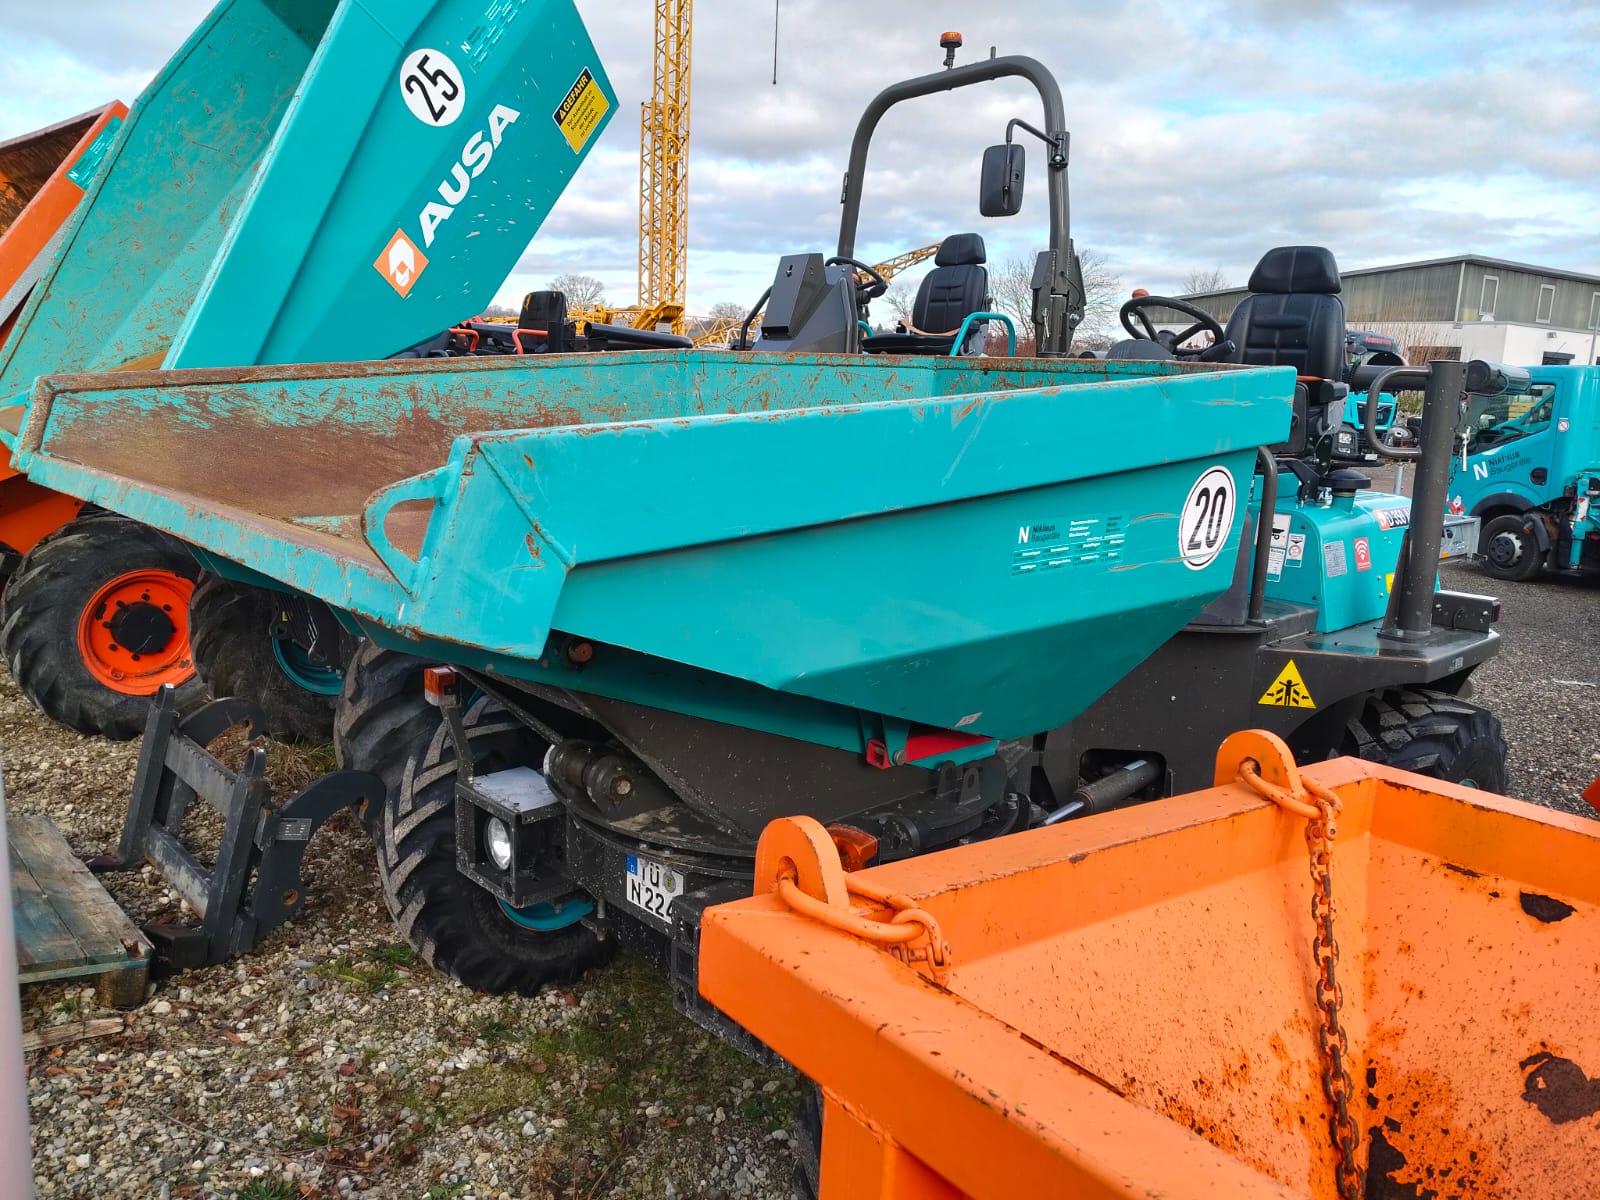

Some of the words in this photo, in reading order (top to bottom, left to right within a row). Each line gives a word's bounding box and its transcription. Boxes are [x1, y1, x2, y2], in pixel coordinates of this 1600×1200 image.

[405, 54, 459, 123] 25
[563, 74, 588, 112] GEFAHR
[419, 104, 521, 248] AUSA
[1018, 526, 1030, 544] N
[1187, 486, 1227, 551] 20
[631, 878, 641, 905] N
